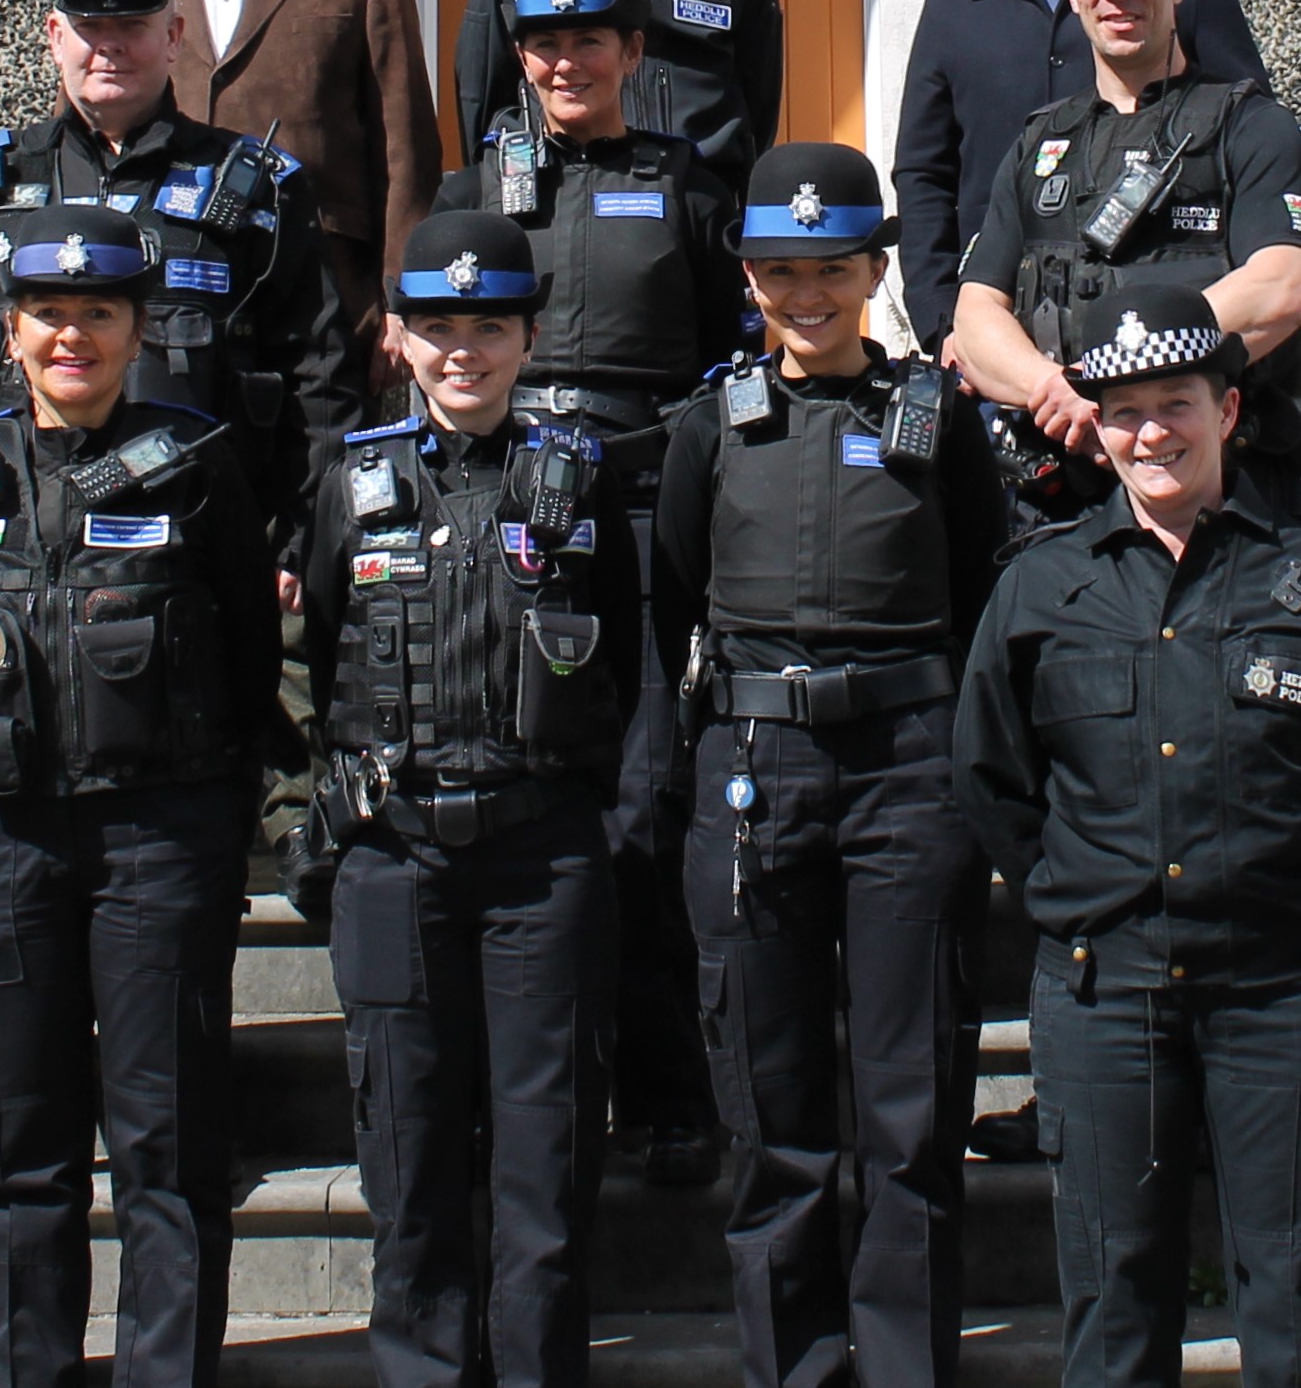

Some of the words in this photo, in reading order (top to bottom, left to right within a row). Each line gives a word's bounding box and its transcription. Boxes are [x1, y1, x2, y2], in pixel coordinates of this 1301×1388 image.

[679, 0, 726, 18] HEDDLU
[682, 9, 723, 25] POLICE
[1171, 206, 1221, 220] HEDDLU
[1172, 218, 1219, 231] POLICE
[390, 564, 426, 575] CYMRAEG
